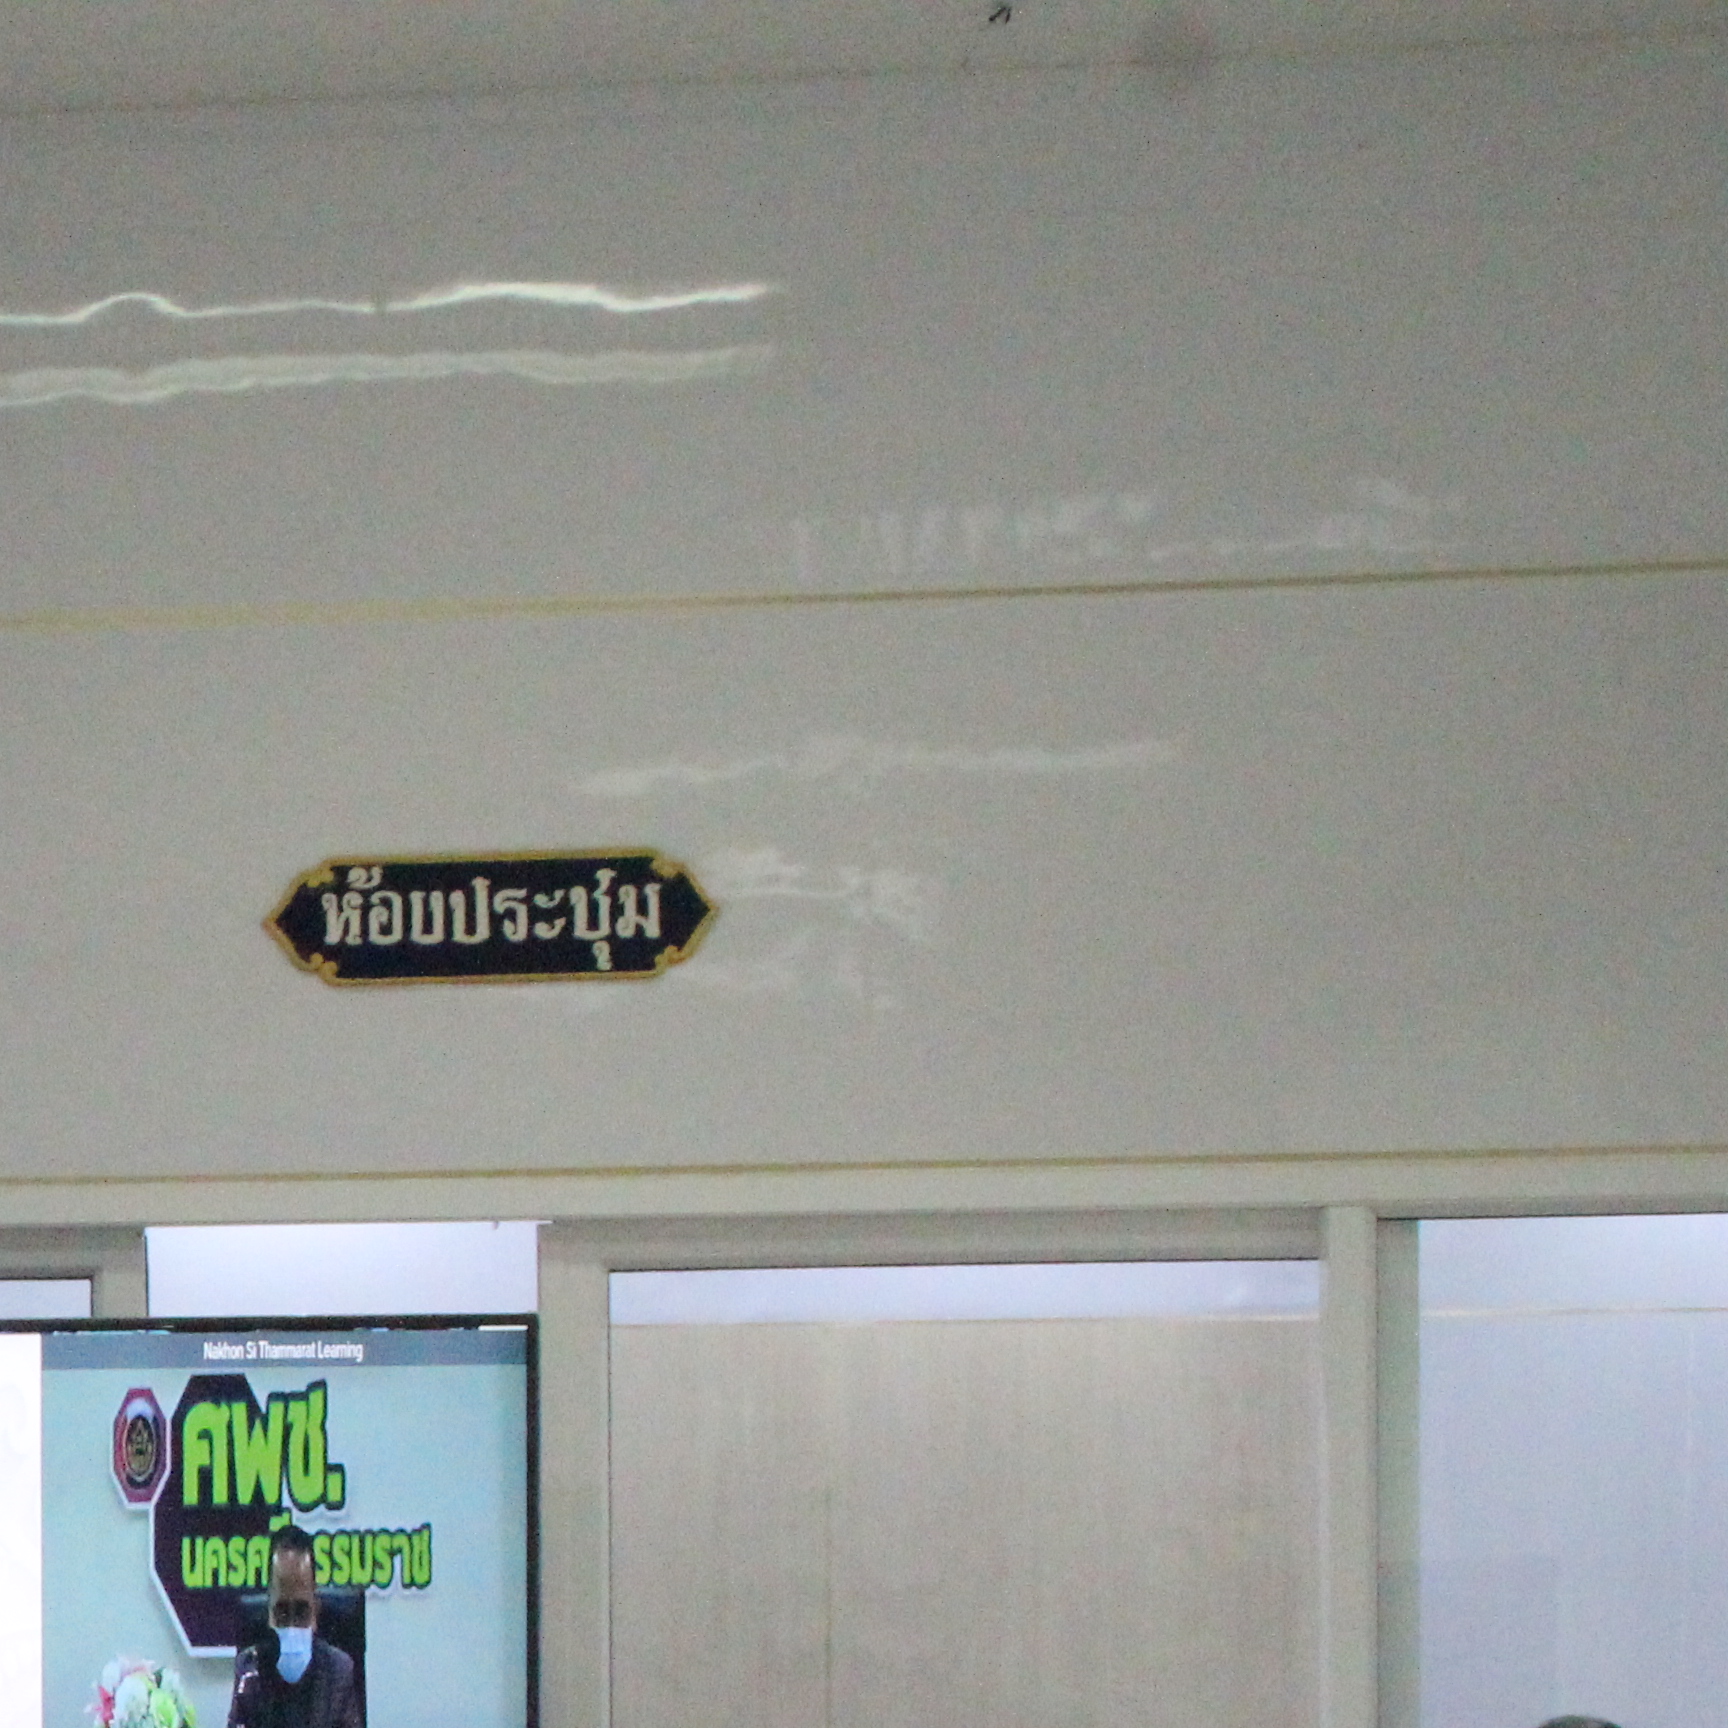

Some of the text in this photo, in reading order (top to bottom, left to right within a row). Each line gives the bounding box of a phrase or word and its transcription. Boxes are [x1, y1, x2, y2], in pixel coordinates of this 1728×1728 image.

[320, 865, 662, 971] ห้องประชุม
[203, 1342, 364, 1362] Nakhon Si Thammarat Learning
[182, 1388, 343, 1506] ศพช.
